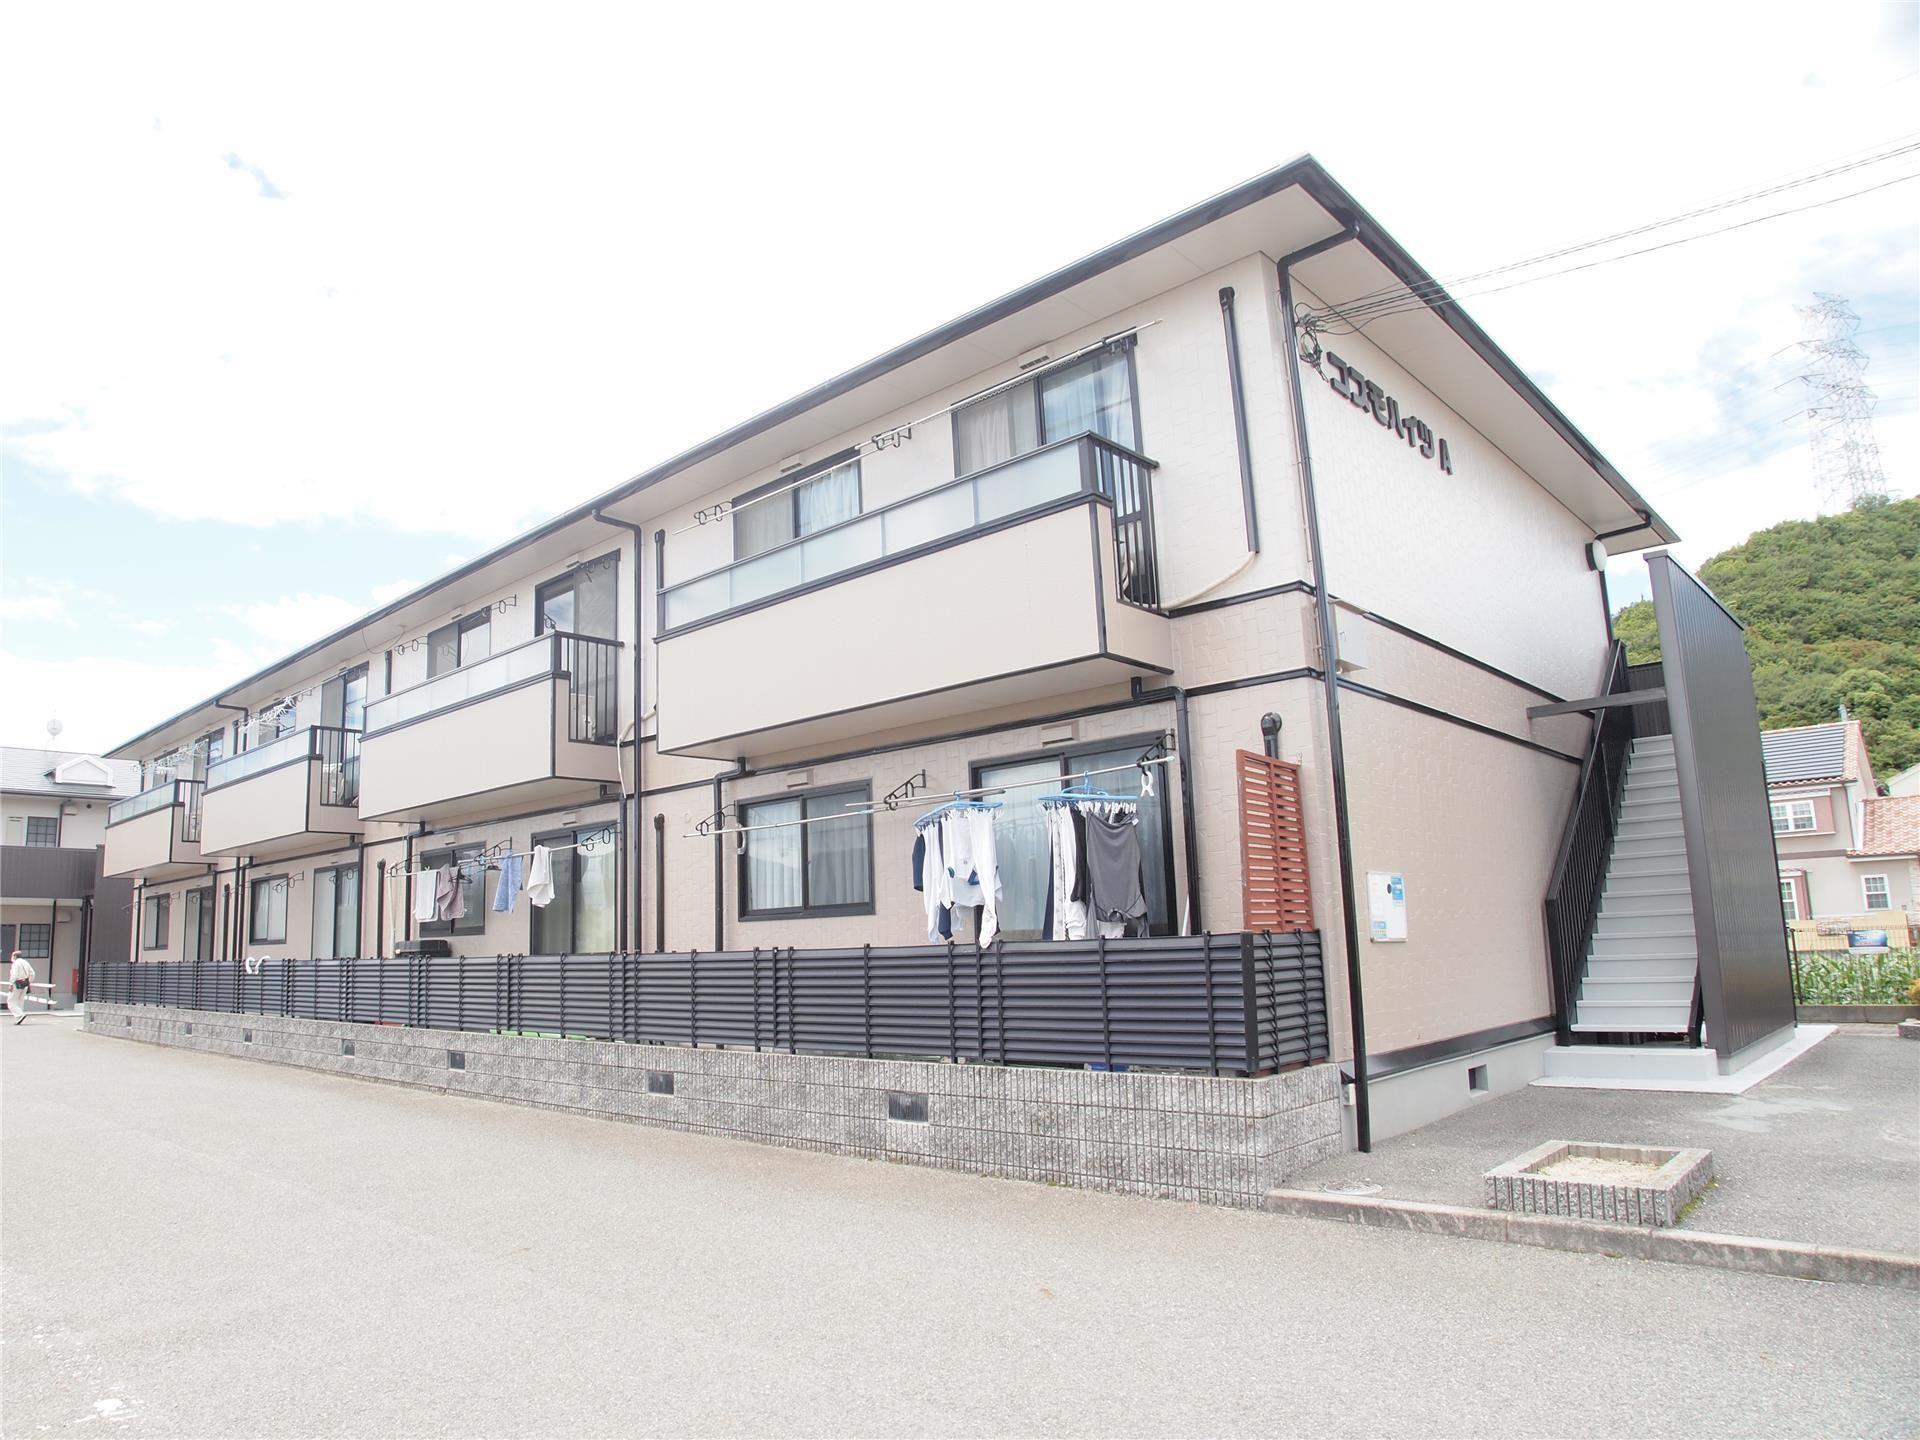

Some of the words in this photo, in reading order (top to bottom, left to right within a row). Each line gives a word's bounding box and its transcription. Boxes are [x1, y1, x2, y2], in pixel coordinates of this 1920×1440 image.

[1326, 351, 1435, 459] コスモハイツ
[1438, 437, 1453, 476] A
